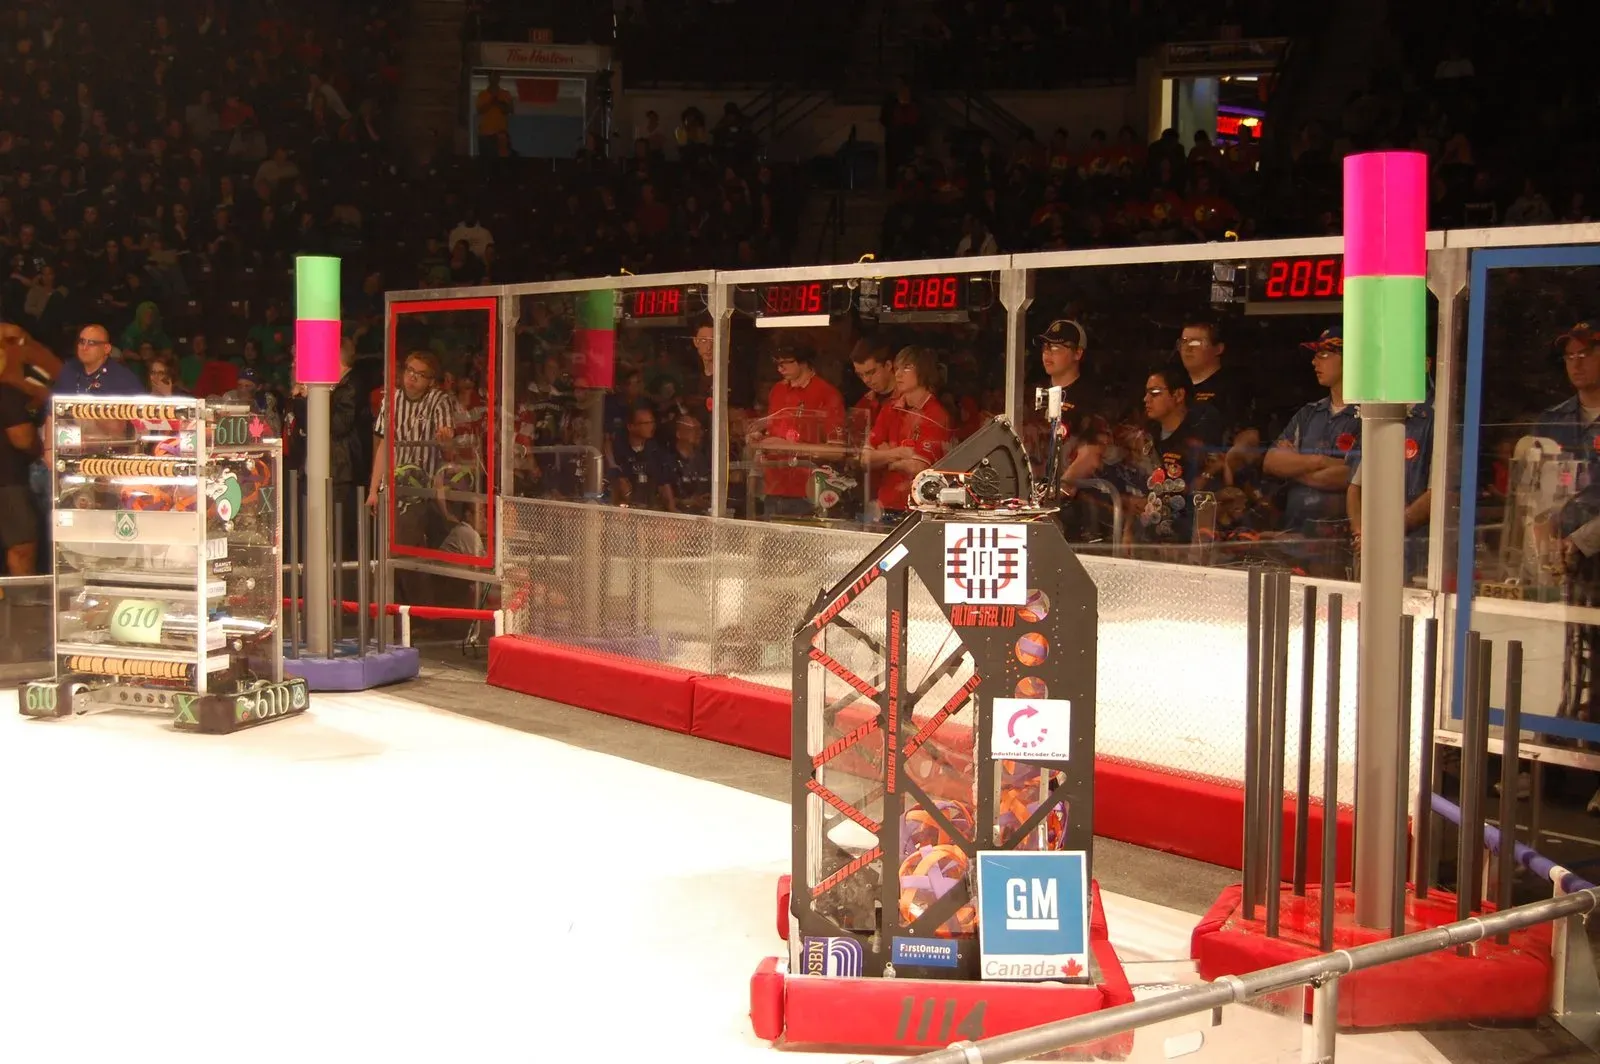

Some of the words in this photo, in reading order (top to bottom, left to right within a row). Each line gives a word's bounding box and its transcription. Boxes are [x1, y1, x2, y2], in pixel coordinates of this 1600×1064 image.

[638, 290, 679, 313] 1114
[800, 284, 821, 312] 15
[894, 278, 957, 308] 2185
[216, 417, 248, 444] 610
[259, 486, 275, 514] X
[973, 550, 993, 576] IFI
[813, 592, 850, 629] TEAM
[852, 565, 880, 595] 1114
[118, 606, 160, 628] 610
[978, 604, 999, 627] STEEL
[1000, 605, 1016, 627] LTD
[808, 647, 880, 699] GOVERNOR
[889, 665, 899, 699] POWDER
[26, 685, 57, 710] 610
[174, 694, 200, 724] X
[256, 686, 290, 719] 610
[888, 700, 898, 733] COATING
[812, 719, 878, 769] SIMCOE
[887, 751, 897, 793] FASTENERS
[805, 778, 881, 834] SECONDARY
[813, 846, 884, 897] SCHOOL
[1006, 877, 1058, 919] GM
[985, 960, 1057, 977] Canada
[895, 996, 987, 1042] 1114
